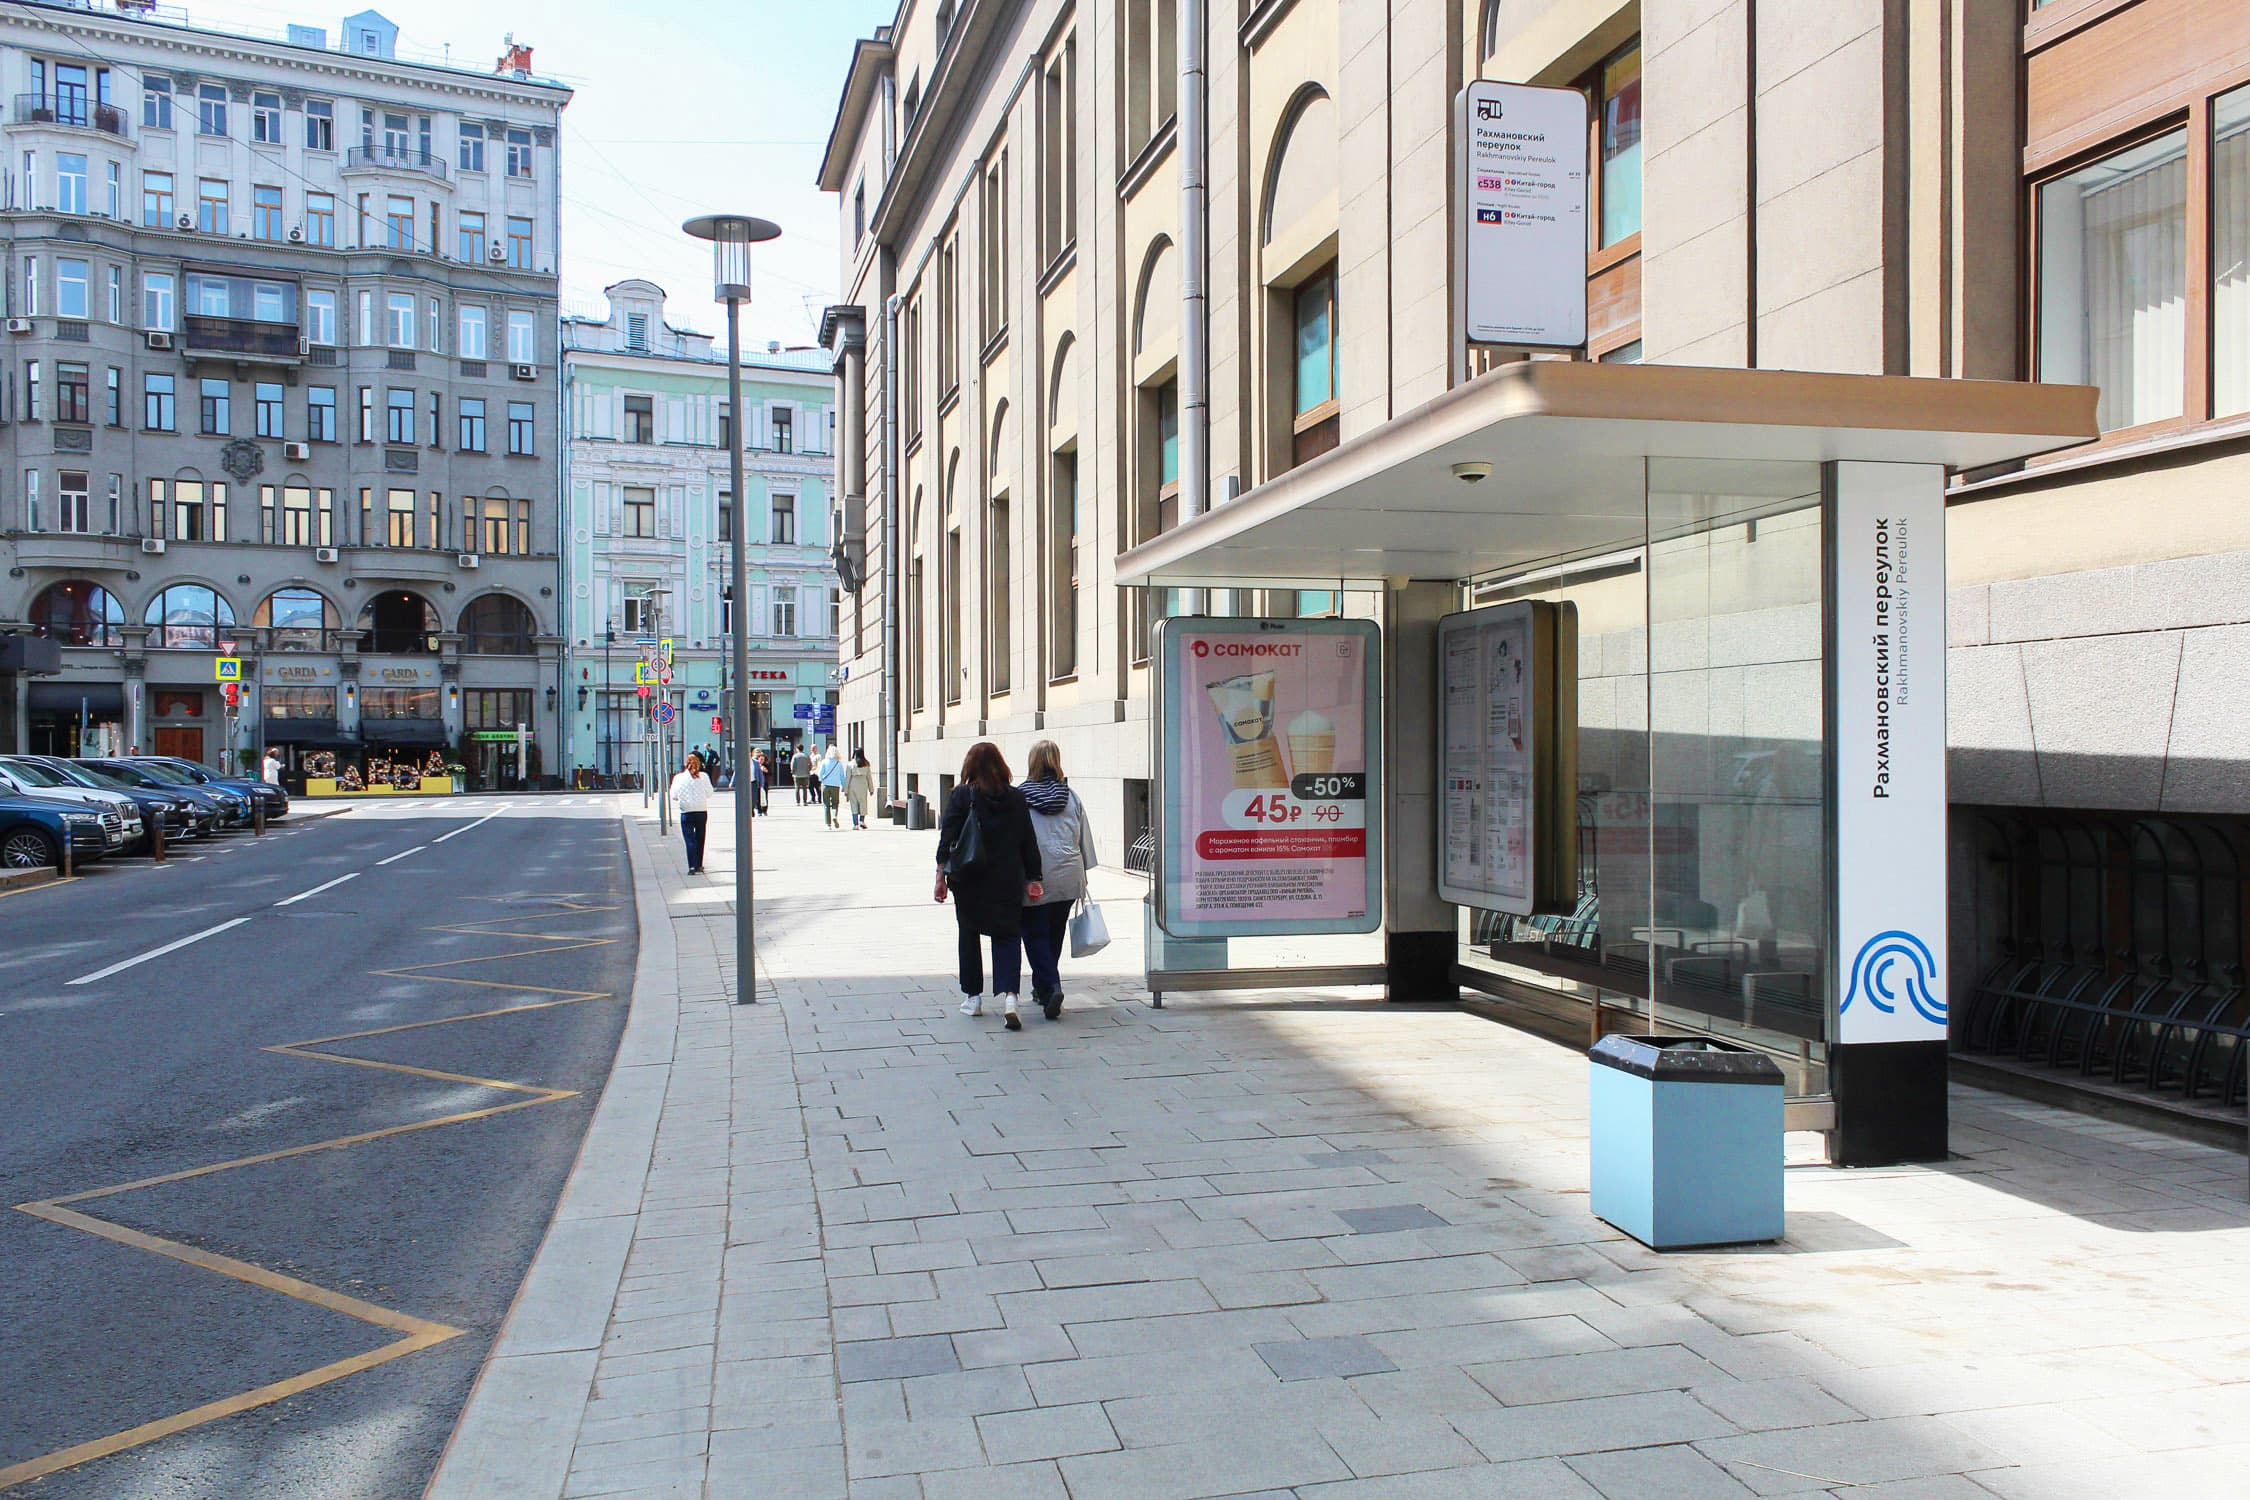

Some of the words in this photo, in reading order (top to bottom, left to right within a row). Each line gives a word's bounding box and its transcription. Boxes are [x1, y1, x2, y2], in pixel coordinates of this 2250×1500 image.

[1477, 128, 1545, 142] Рахмановский
[1477, 141, 1521, 151] переулок
[1528, 155, 1556, 163] Pereulok
[1478, 179, 1501, 189] с538
[1517, 180, 1556, 189] Китай-город
[1483, 212, 1496, 221] н6
[1517, 212, 1556, 222] Китай-город
[1896, 517, 1908, 583] Pereulok
[1875, 518, 1892, 626] переулок
[1896, 589, 1909, 705] Rakhmanovskiy
[278, 666, 317, 677] GARDA
[382, 668, 418, 678] GARDA
[1873, 634, 1890, 799] Рахмановский
[1304, 776, 1355, 796] -50%
